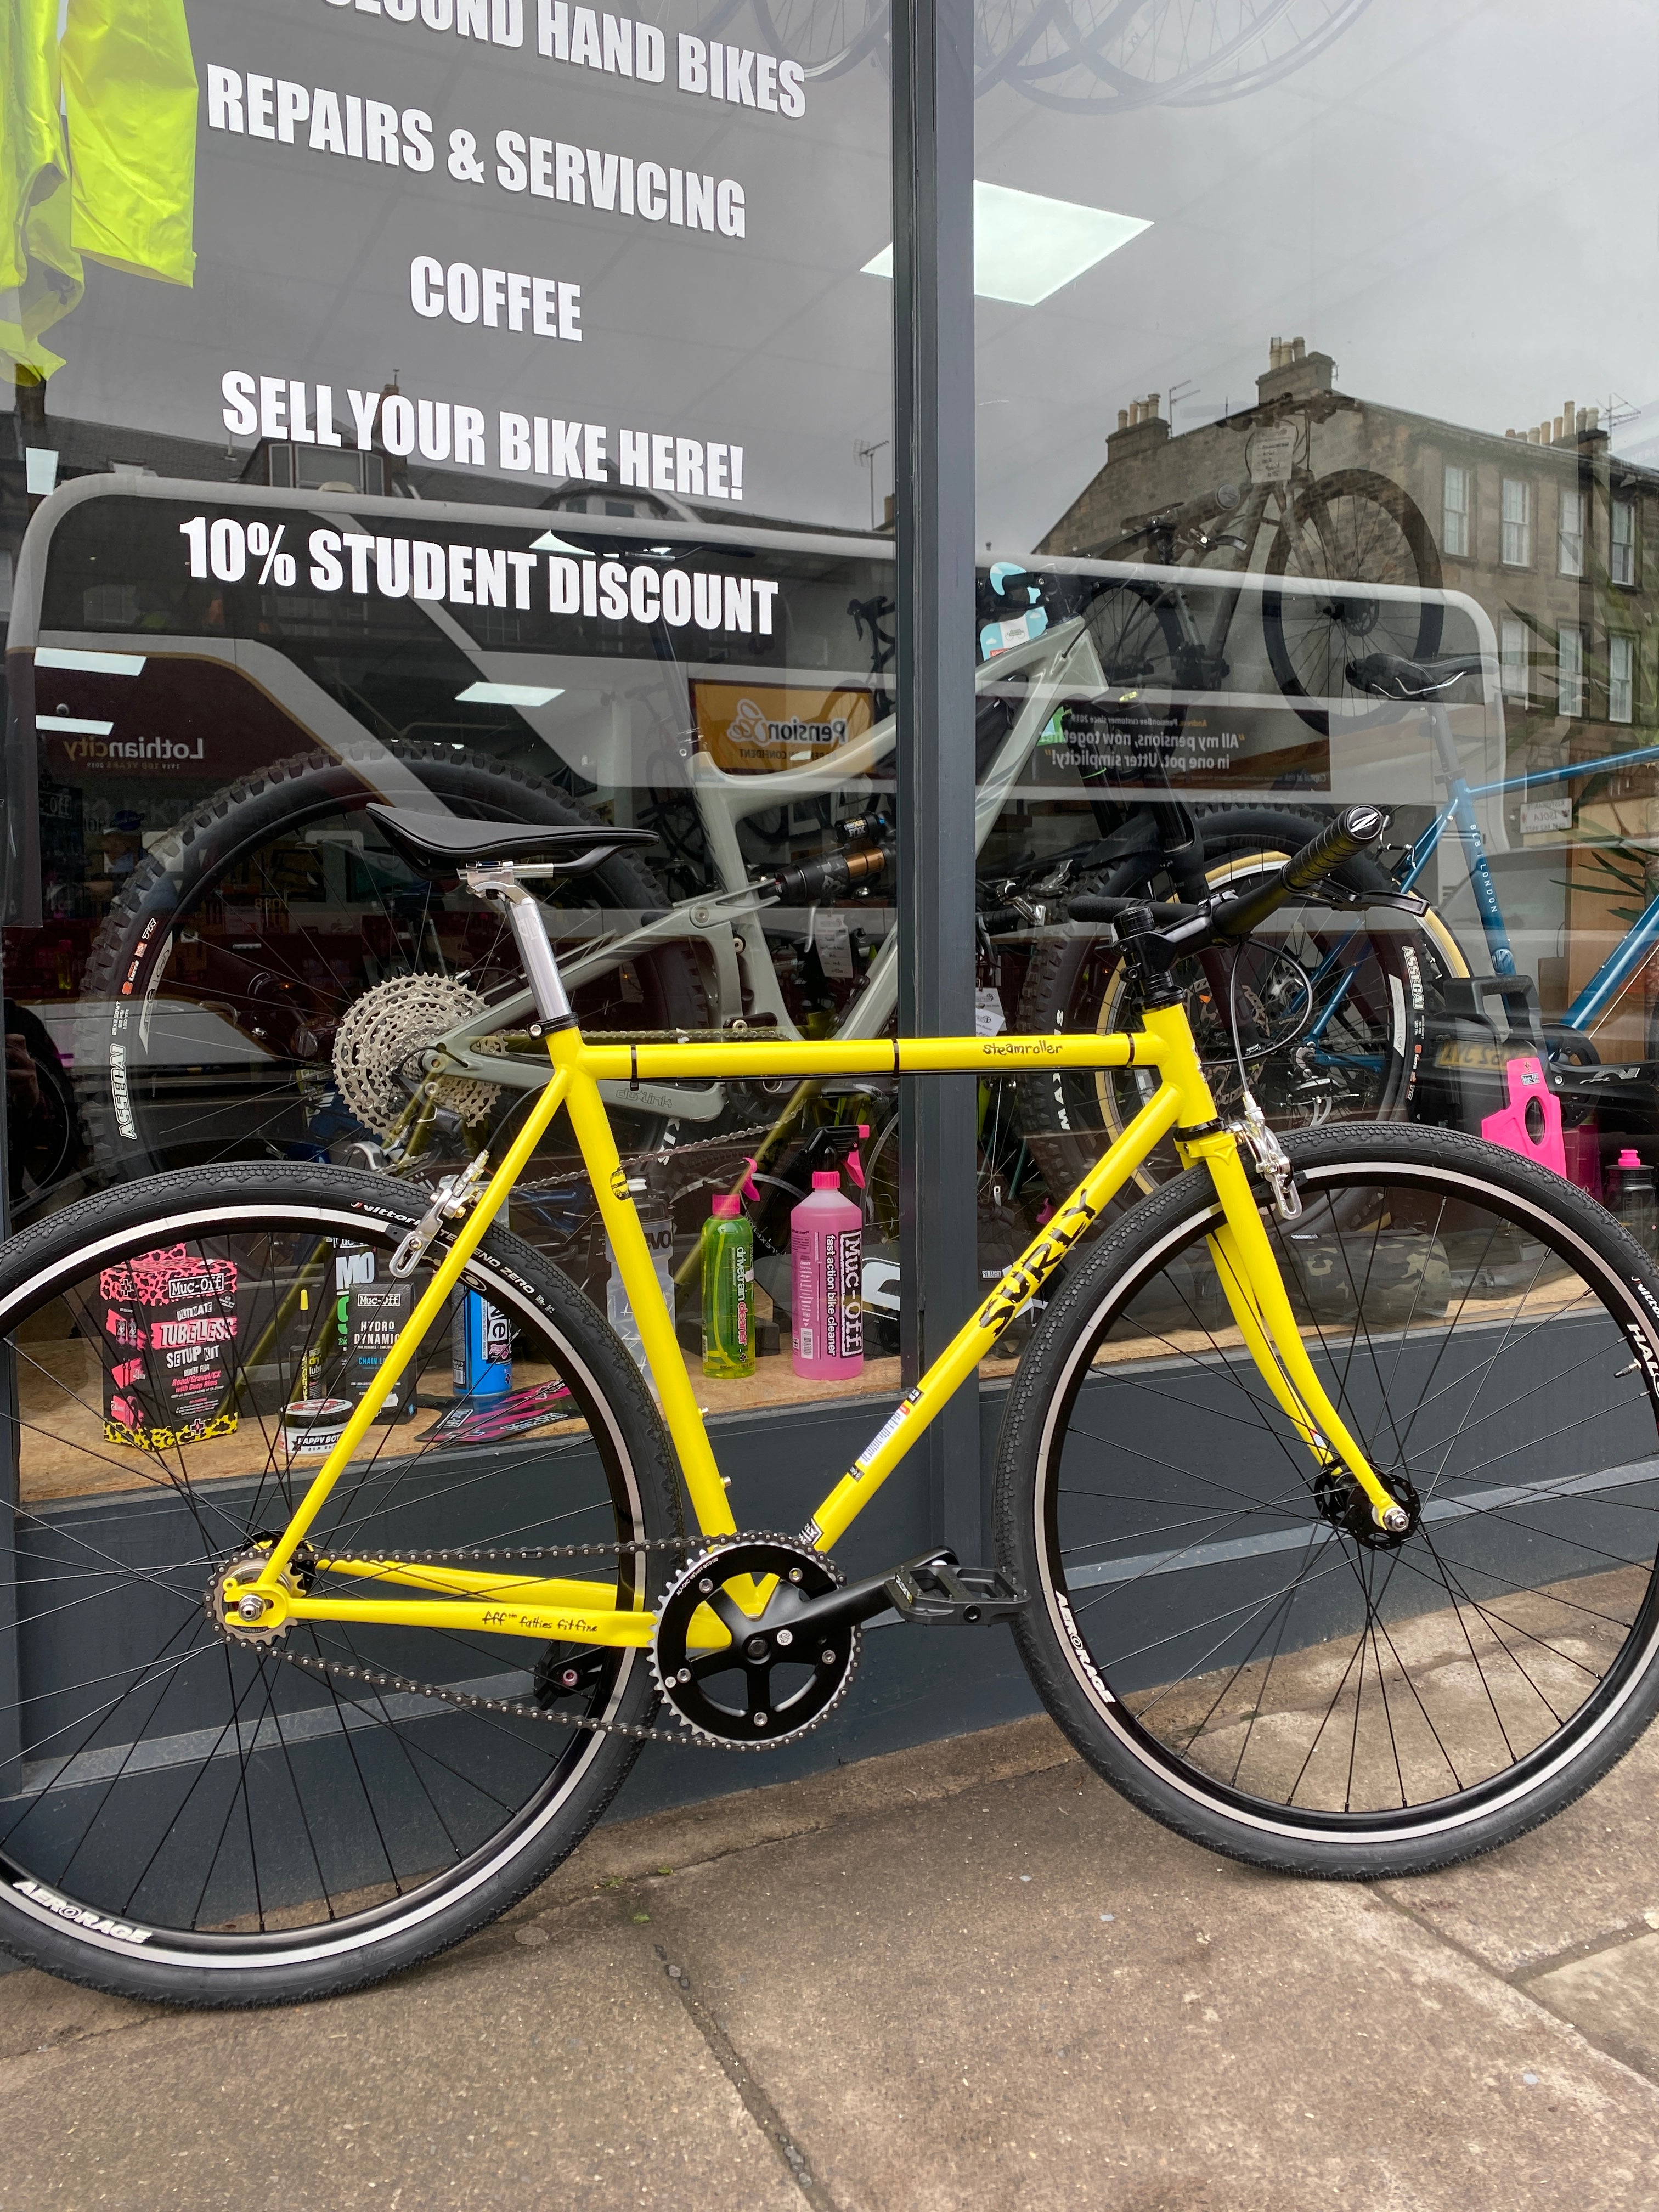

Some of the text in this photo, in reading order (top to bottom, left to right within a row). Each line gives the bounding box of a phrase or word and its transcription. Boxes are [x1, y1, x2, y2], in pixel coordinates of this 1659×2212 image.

[537, 0, 665, 84] HAND
[678, 32, 806, 119] BIKES
[207, 64, 746, 239] REPAIRS & SERVICING
[410, 256, 583, 342] COFFEE
[222, 370, 744, 501] SELL YOUR BIKE HERE!
[179, 516, 779, 636] 10% STUDENT DISCOUNT
[849, 825, 866, 838] FOX
[1470, 824, 1498, 913] BLB LONDON
[1402, 946, 1424, 1010] ASSEGAI
[983, 1040, 1063, 1056] steamroller
[110, 1043, 137, 1139] ASSEGAI
[979, 1189, 1096, 1339] SURLY
[981, 1269, 1002, 1278] STRAIGHT
[171, 1276, 222, 1295] Muc-Off
[500, 1266, 535, 1294] ZERO
[359, 1296, 399, 1305] Muc-Off
[736, 1246, 748, 1346] drivetrain cleaner
[826, 1234, 838, 1356] fast action bike cleaner
[843, 1237, 862, 1352] Muc-Off
[177, 1301, 213, 1321] ULTIMATE
[161, 1318, 234, 1347] TUBELESS
[360, 1321, 395, 1332] HYDRO
[166, 1344, 220, 1369] SETUP KIT
[309, 1356, 320, 1366] dry
[309, 1364, 322, 1375] lube
[358, 1357, 377, 1365] CHAIN
[172, 1370, 222, 1387] Road/Gravel/CX
[175, 1385, 189, 1394] with
[204, 1379, 218, 1389] Rims
[519, 1615, 553, 1629] fatties
[557, 1618, 574, 1631] fit
[574, 1618, 598, 1632] fine
